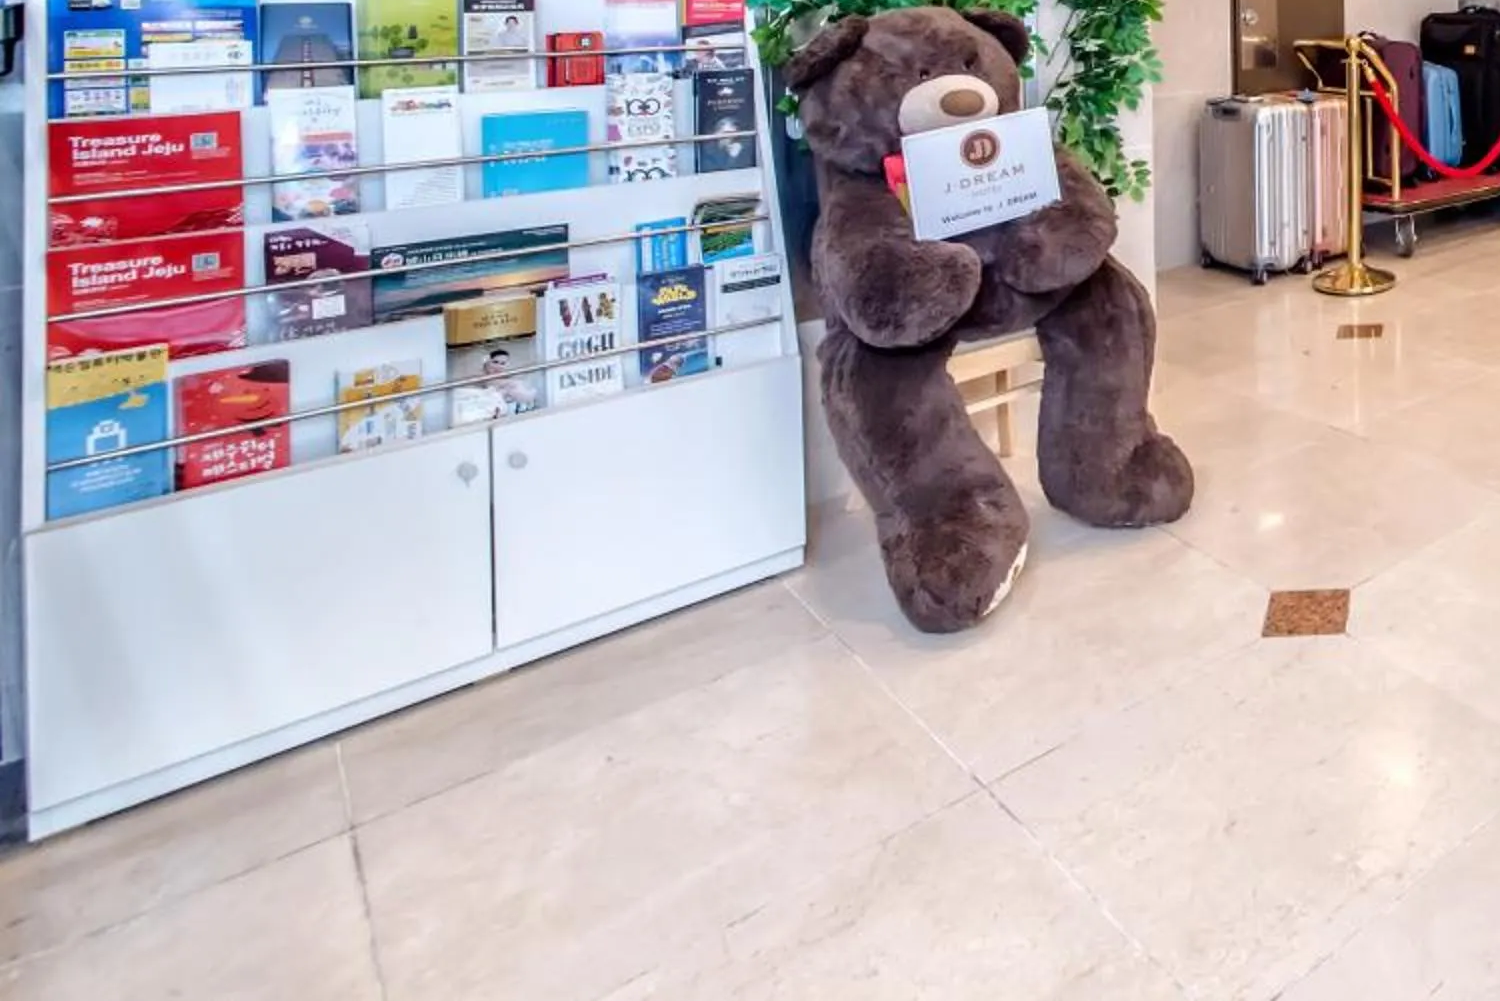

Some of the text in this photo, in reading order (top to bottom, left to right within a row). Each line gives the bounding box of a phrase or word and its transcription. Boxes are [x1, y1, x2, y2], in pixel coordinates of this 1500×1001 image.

[68, 133, 162, 148] Treasure
[72, 147, 136, 160] Island
[141, 142, 184, 157] Jeju
[959, 163, 1025, 190] DREAM
[68, 255, 163, 276] Treasure
[72, 269, 137, 288] Island
[142, 264, 186, 280] Jeju
[558, 331, 615, 360] GOGH
[559, 364, 614, 390] INSIDE
